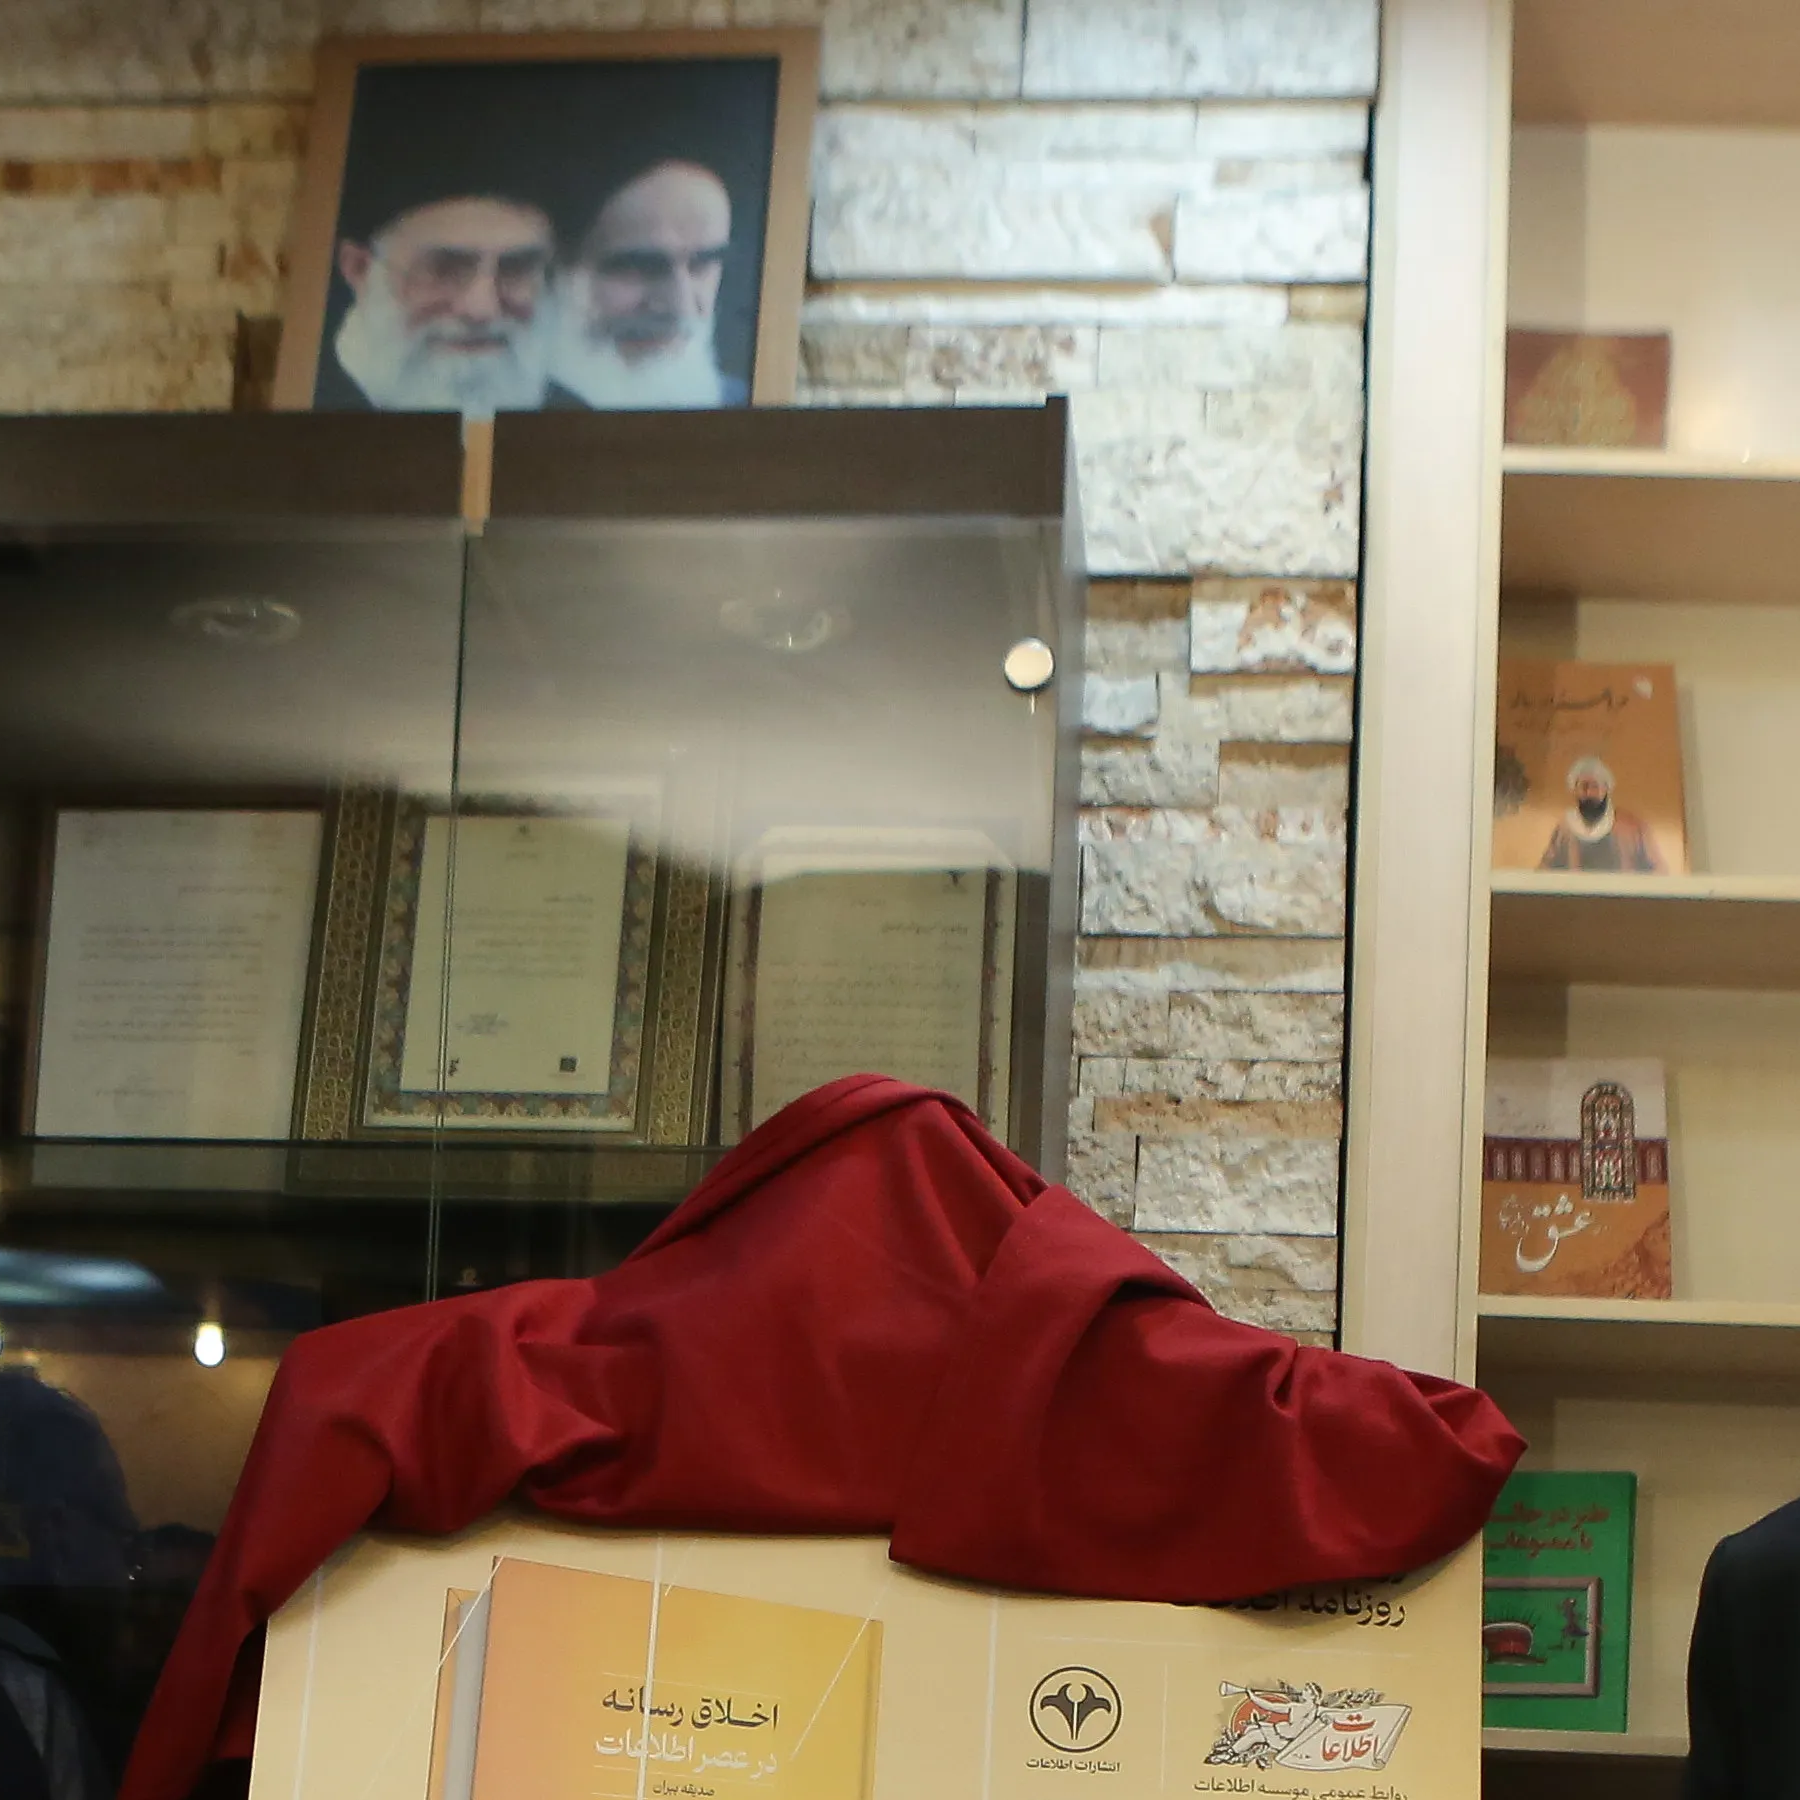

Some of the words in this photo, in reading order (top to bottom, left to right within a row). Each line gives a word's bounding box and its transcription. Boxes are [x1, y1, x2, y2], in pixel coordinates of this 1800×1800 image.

[602, 1686, 685, 1727] رسانه
[691, 1697, 781, 1731] اخلاق
[595, 1728, 695, 1762] اطلاعات
[693, 1750, 749, 1773] عصر
[750, 1752, 778, 1780] در
[1025, 1757, 1073, 1770] اطلاعات
[1074, 1760, 1121, 1774] انتشارات
[1193, 1776, 1255, 1794] اطلاعات
